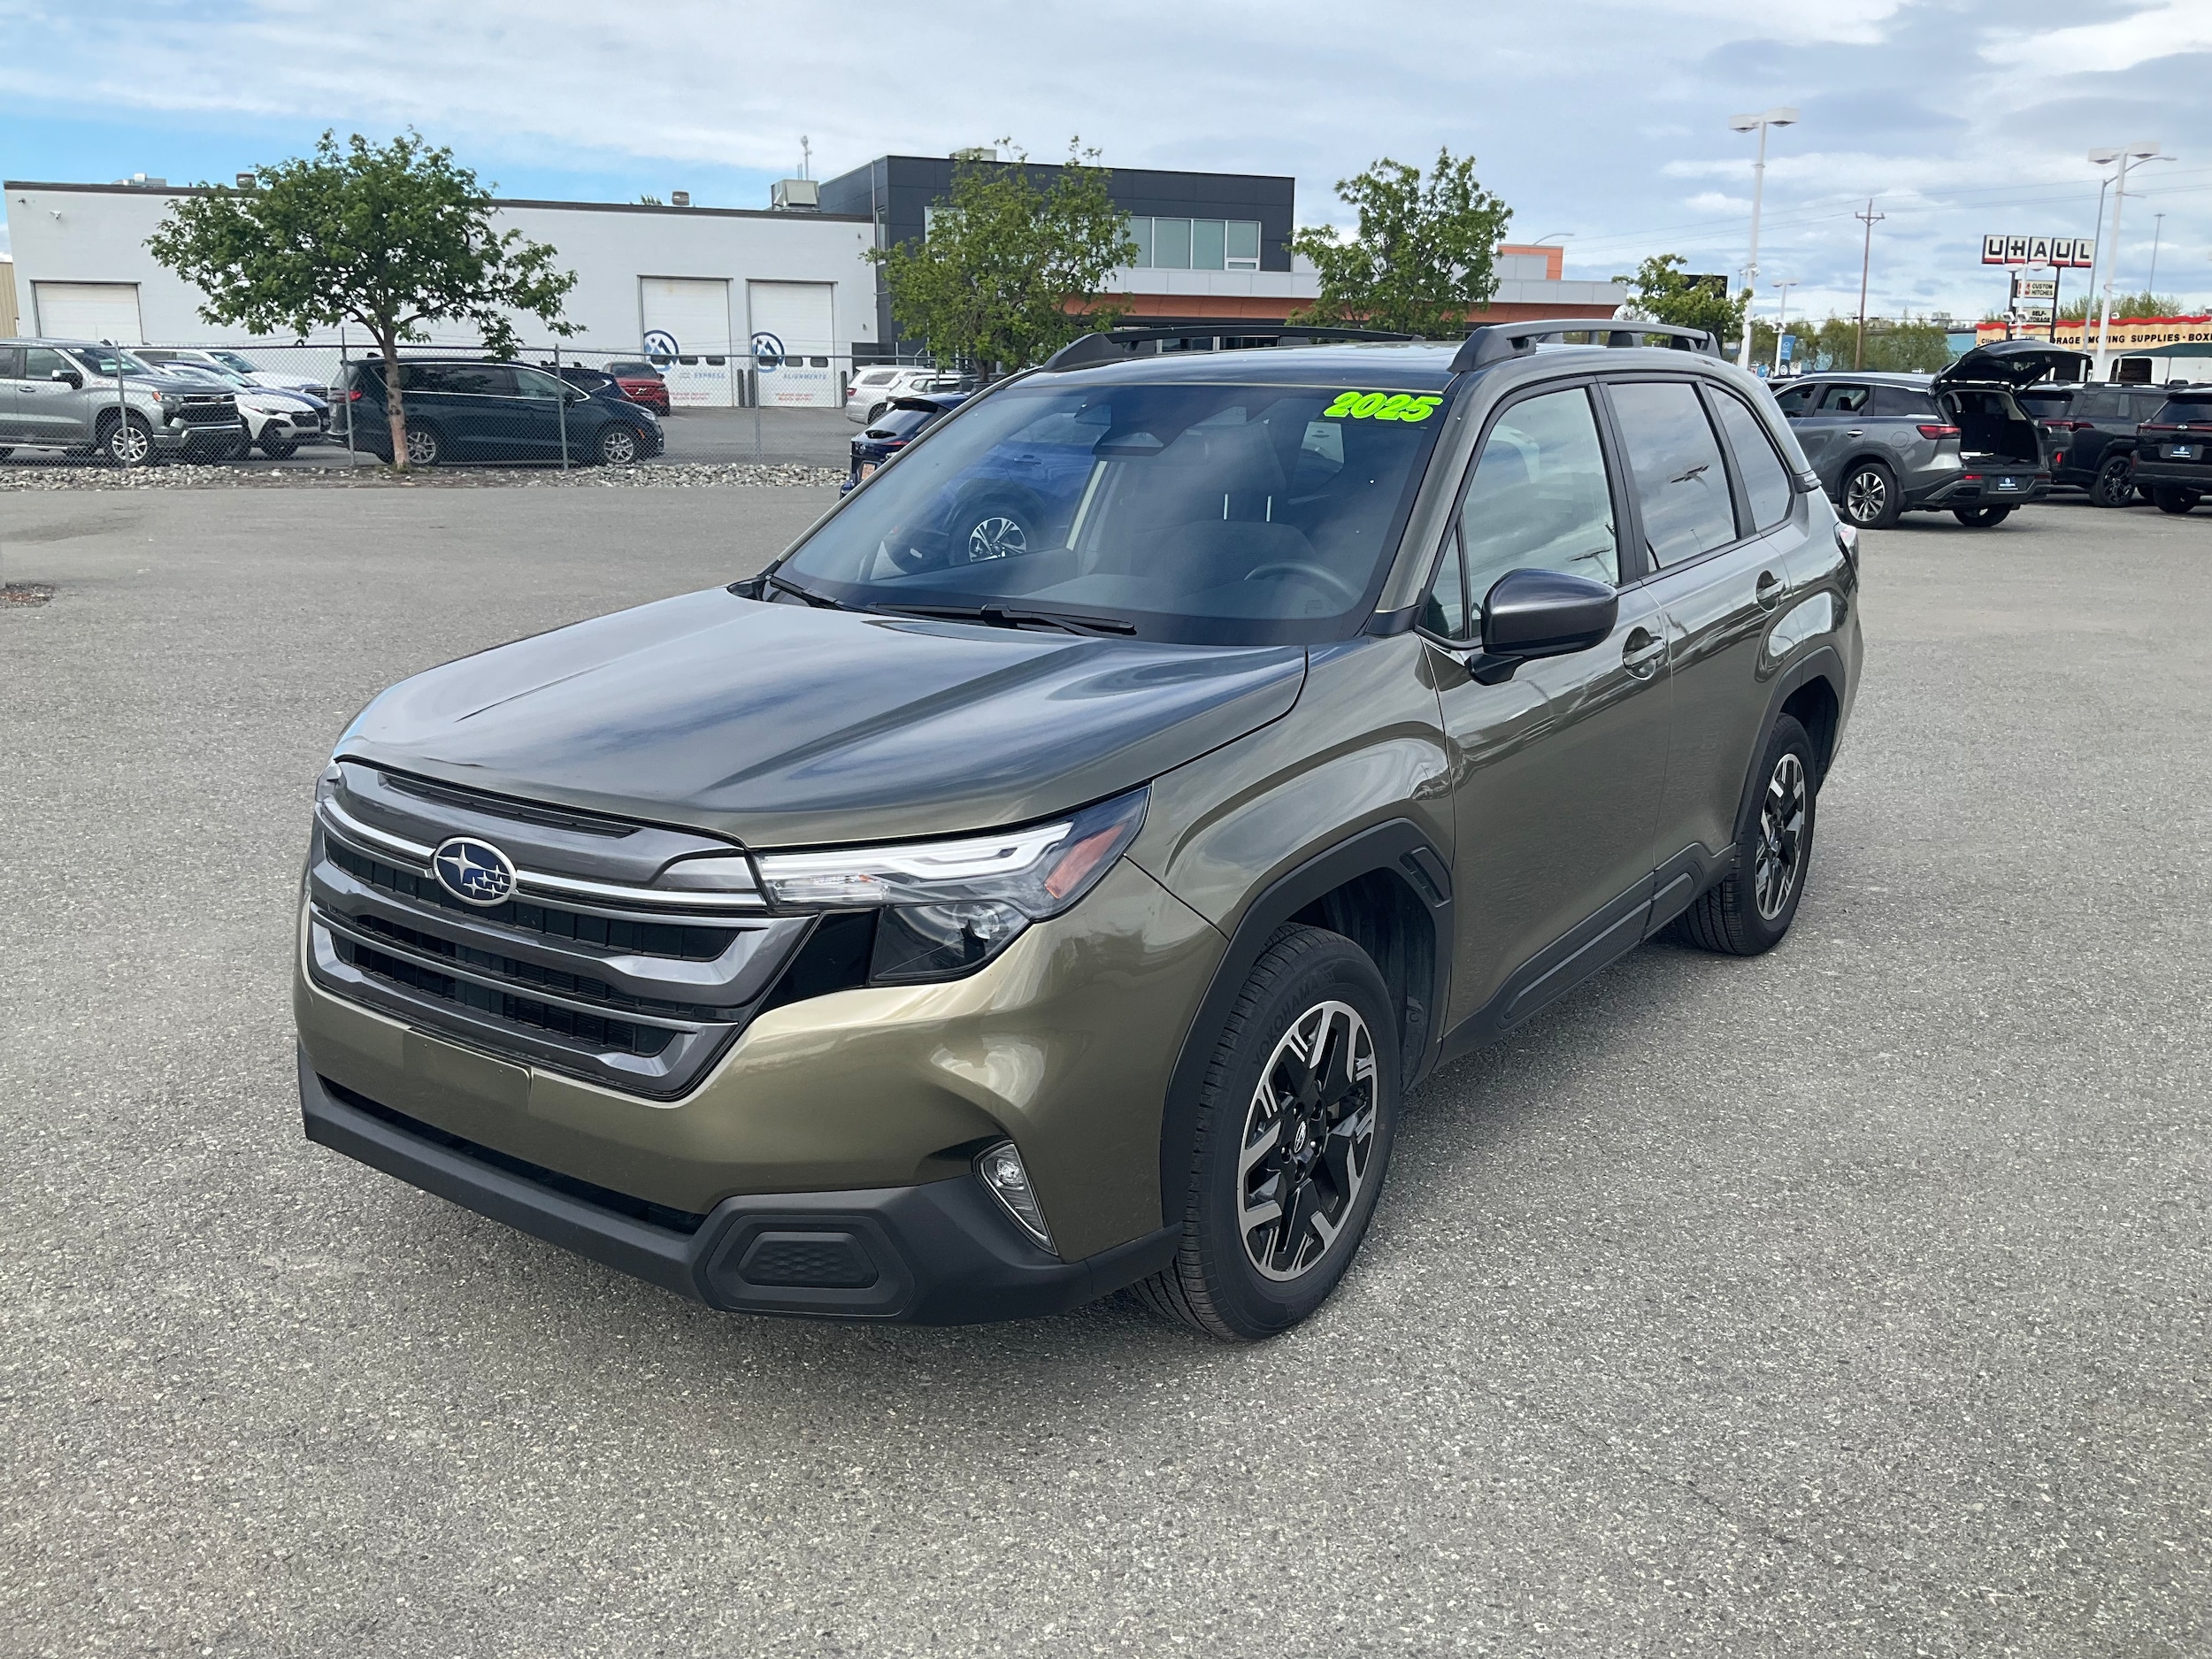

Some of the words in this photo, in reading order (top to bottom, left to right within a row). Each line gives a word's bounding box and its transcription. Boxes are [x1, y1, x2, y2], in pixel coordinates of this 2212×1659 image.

[2131, 334, 2180, 342] SUPPLIES
[1324, 391, 1444, 422] 2025
[1252, 974, 1319, 1067] YOKOHAMA
